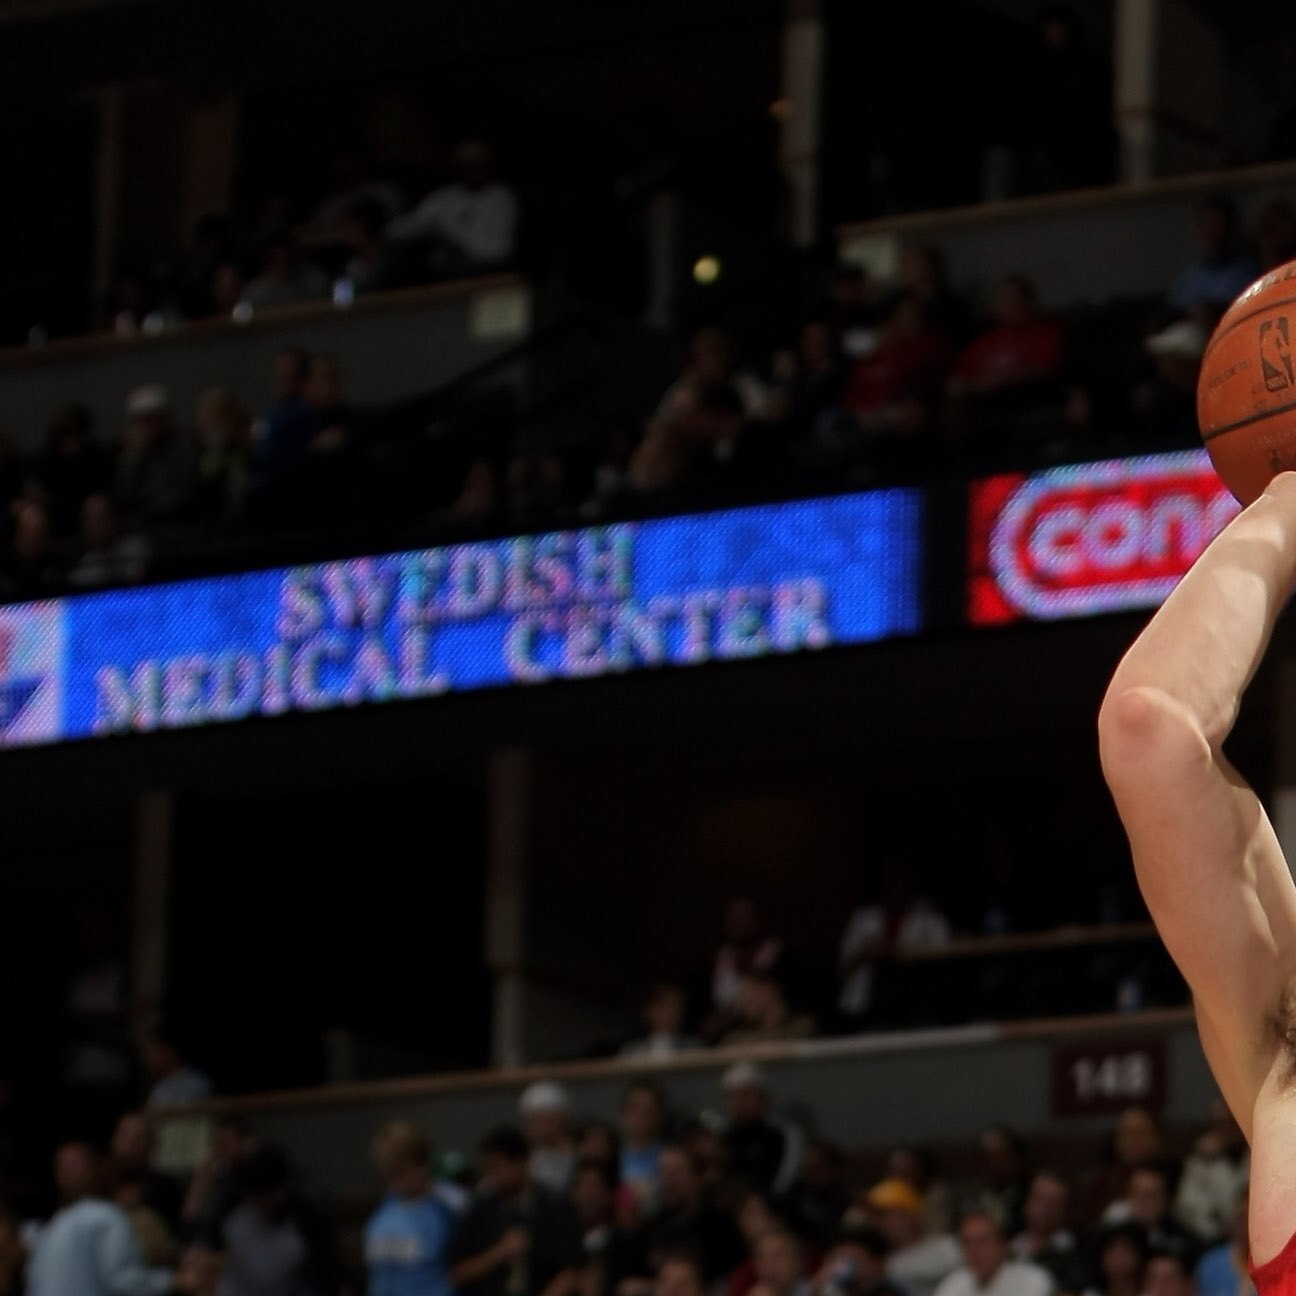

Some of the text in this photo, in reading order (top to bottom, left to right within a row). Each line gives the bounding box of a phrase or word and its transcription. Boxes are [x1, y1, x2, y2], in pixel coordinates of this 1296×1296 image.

[277, 522, 636, 641] SWEDISH
[1028, 489, 1243, 575] con
[93, 577, 832, 737] MEDICAL CENTER
